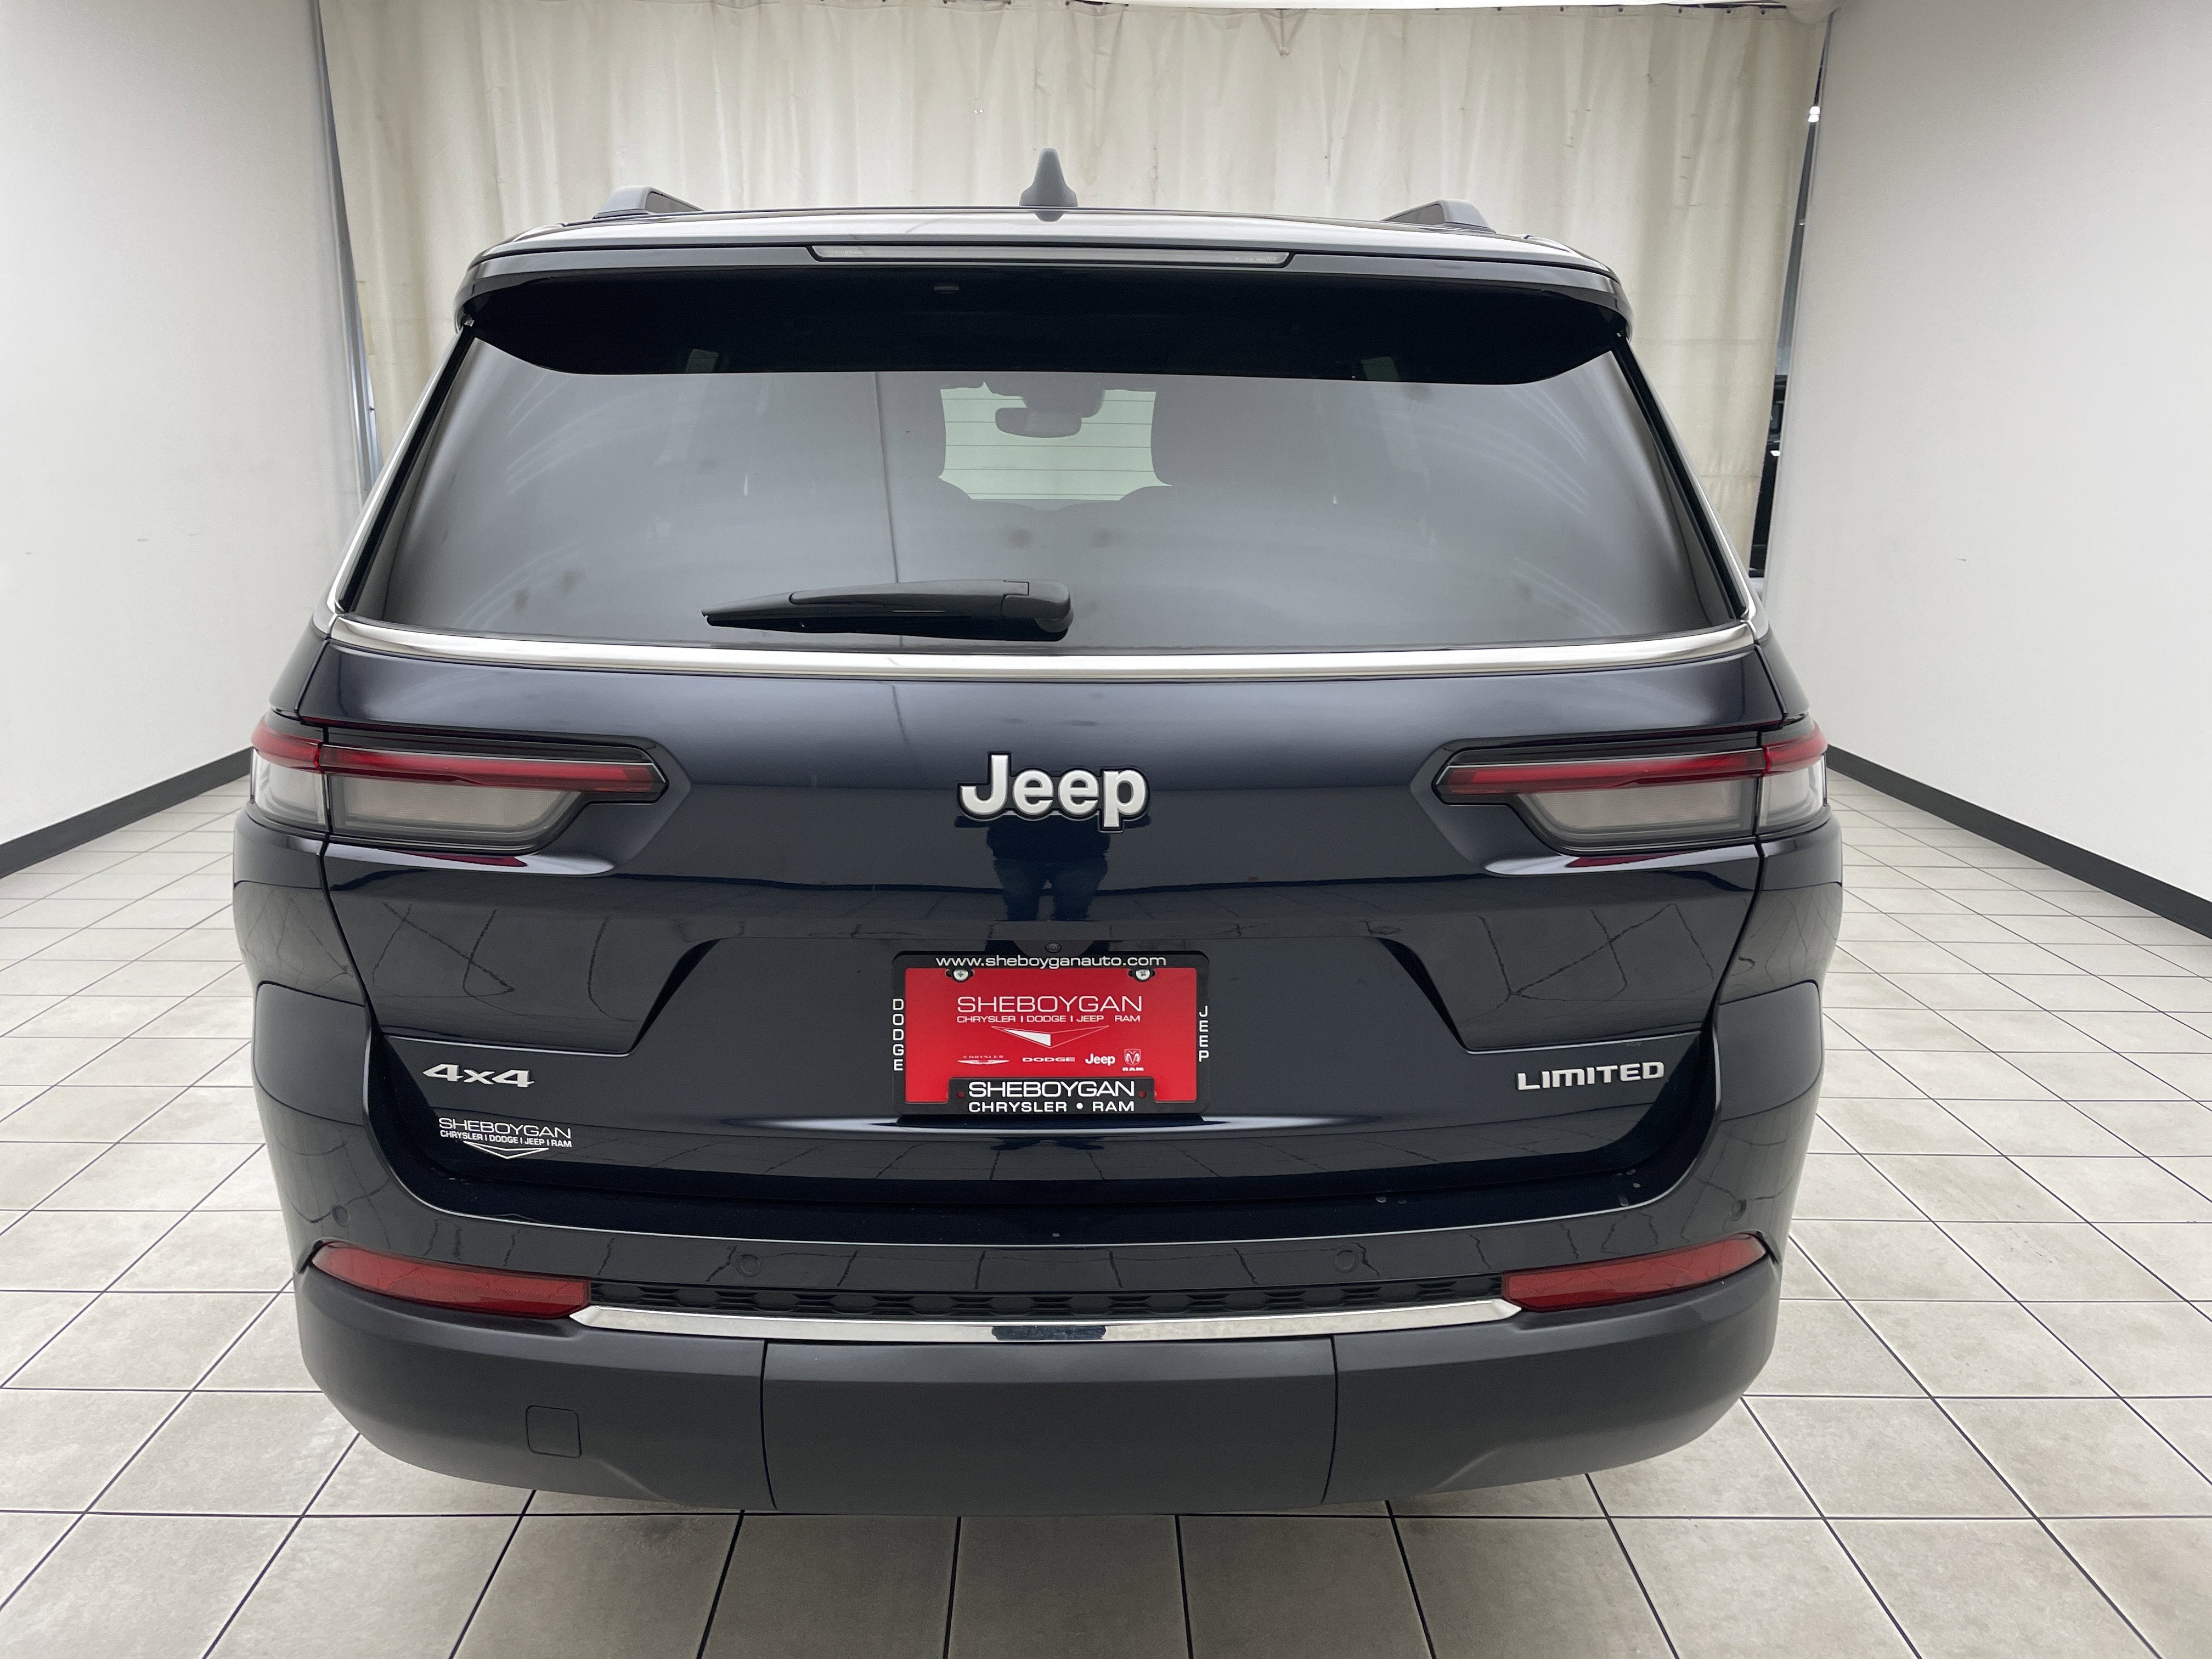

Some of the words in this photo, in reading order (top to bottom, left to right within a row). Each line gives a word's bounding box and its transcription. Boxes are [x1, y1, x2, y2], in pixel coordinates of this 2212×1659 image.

[959, 754, 1147, 828] Jeep
[935, 955, 1166, 969] www.sheboyganauto.com
[957, 995, 1142, 1013] SHEBOYGAN
[956, 1015, 1016, 1023] CHRYSLER
[893, 998, 904, 1071] DODGE
[1199, 1005, 1209, 1062] JEEP
[1085, 1053, 1116, 1066] Jeep
[422, 1063, 534, 1088] 4x4
[1516, 1061, 1665, 1091] LIMITED
[968, 1081, 1135, 1097] SHEBOYGAN
[968, 1101, 1067, 1113] CHRYSLER
[1092, 1101, 1135, 1112] RAM
[438, 1117, 572, 1139] SHEBOYGAN
[439, 1130, 483, 1141] CHRYSLER
[489, 1135, 518, 1144] DODGE
[524, 1137, 545, 1146] JEEP
[551, 1139, 572, 1148] RAM
